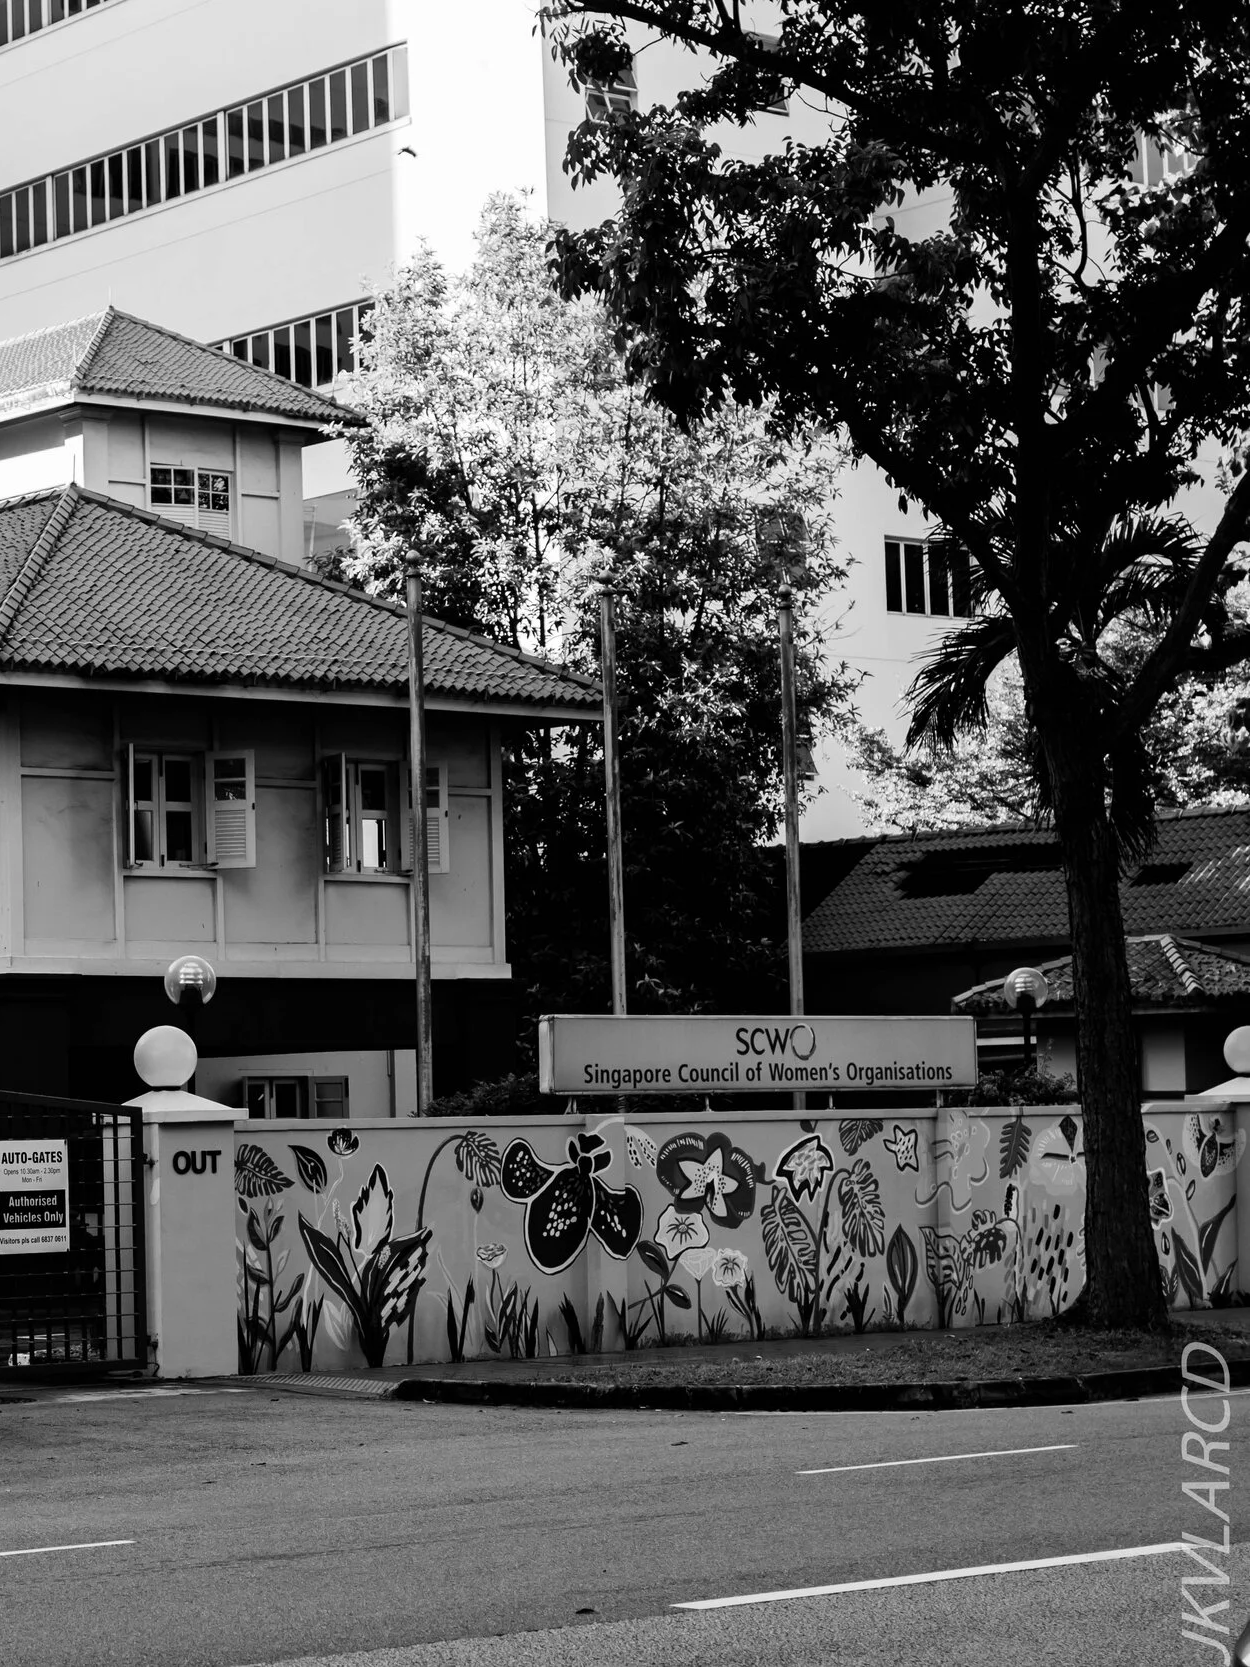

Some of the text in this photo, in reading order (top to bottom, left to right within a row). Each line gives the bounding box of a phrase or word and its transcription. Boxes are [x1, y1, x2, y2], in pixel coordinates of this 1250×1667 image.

[735, 1023, 817, 1060] SCWO
[583, 1061, 953, 1089] Singapore Council of Women's Organisations
[1, 1151, 63, 1164] AUTO-GATES
[173, 1150, 222, 1175] OUT
[8, 1195, 57, 1207] Authorised
[3, 1211, 64, 1224] Vehicles Only
[0, 1237, 20, 1245] Visitors
[21, 1237, 30, 1245] pls
